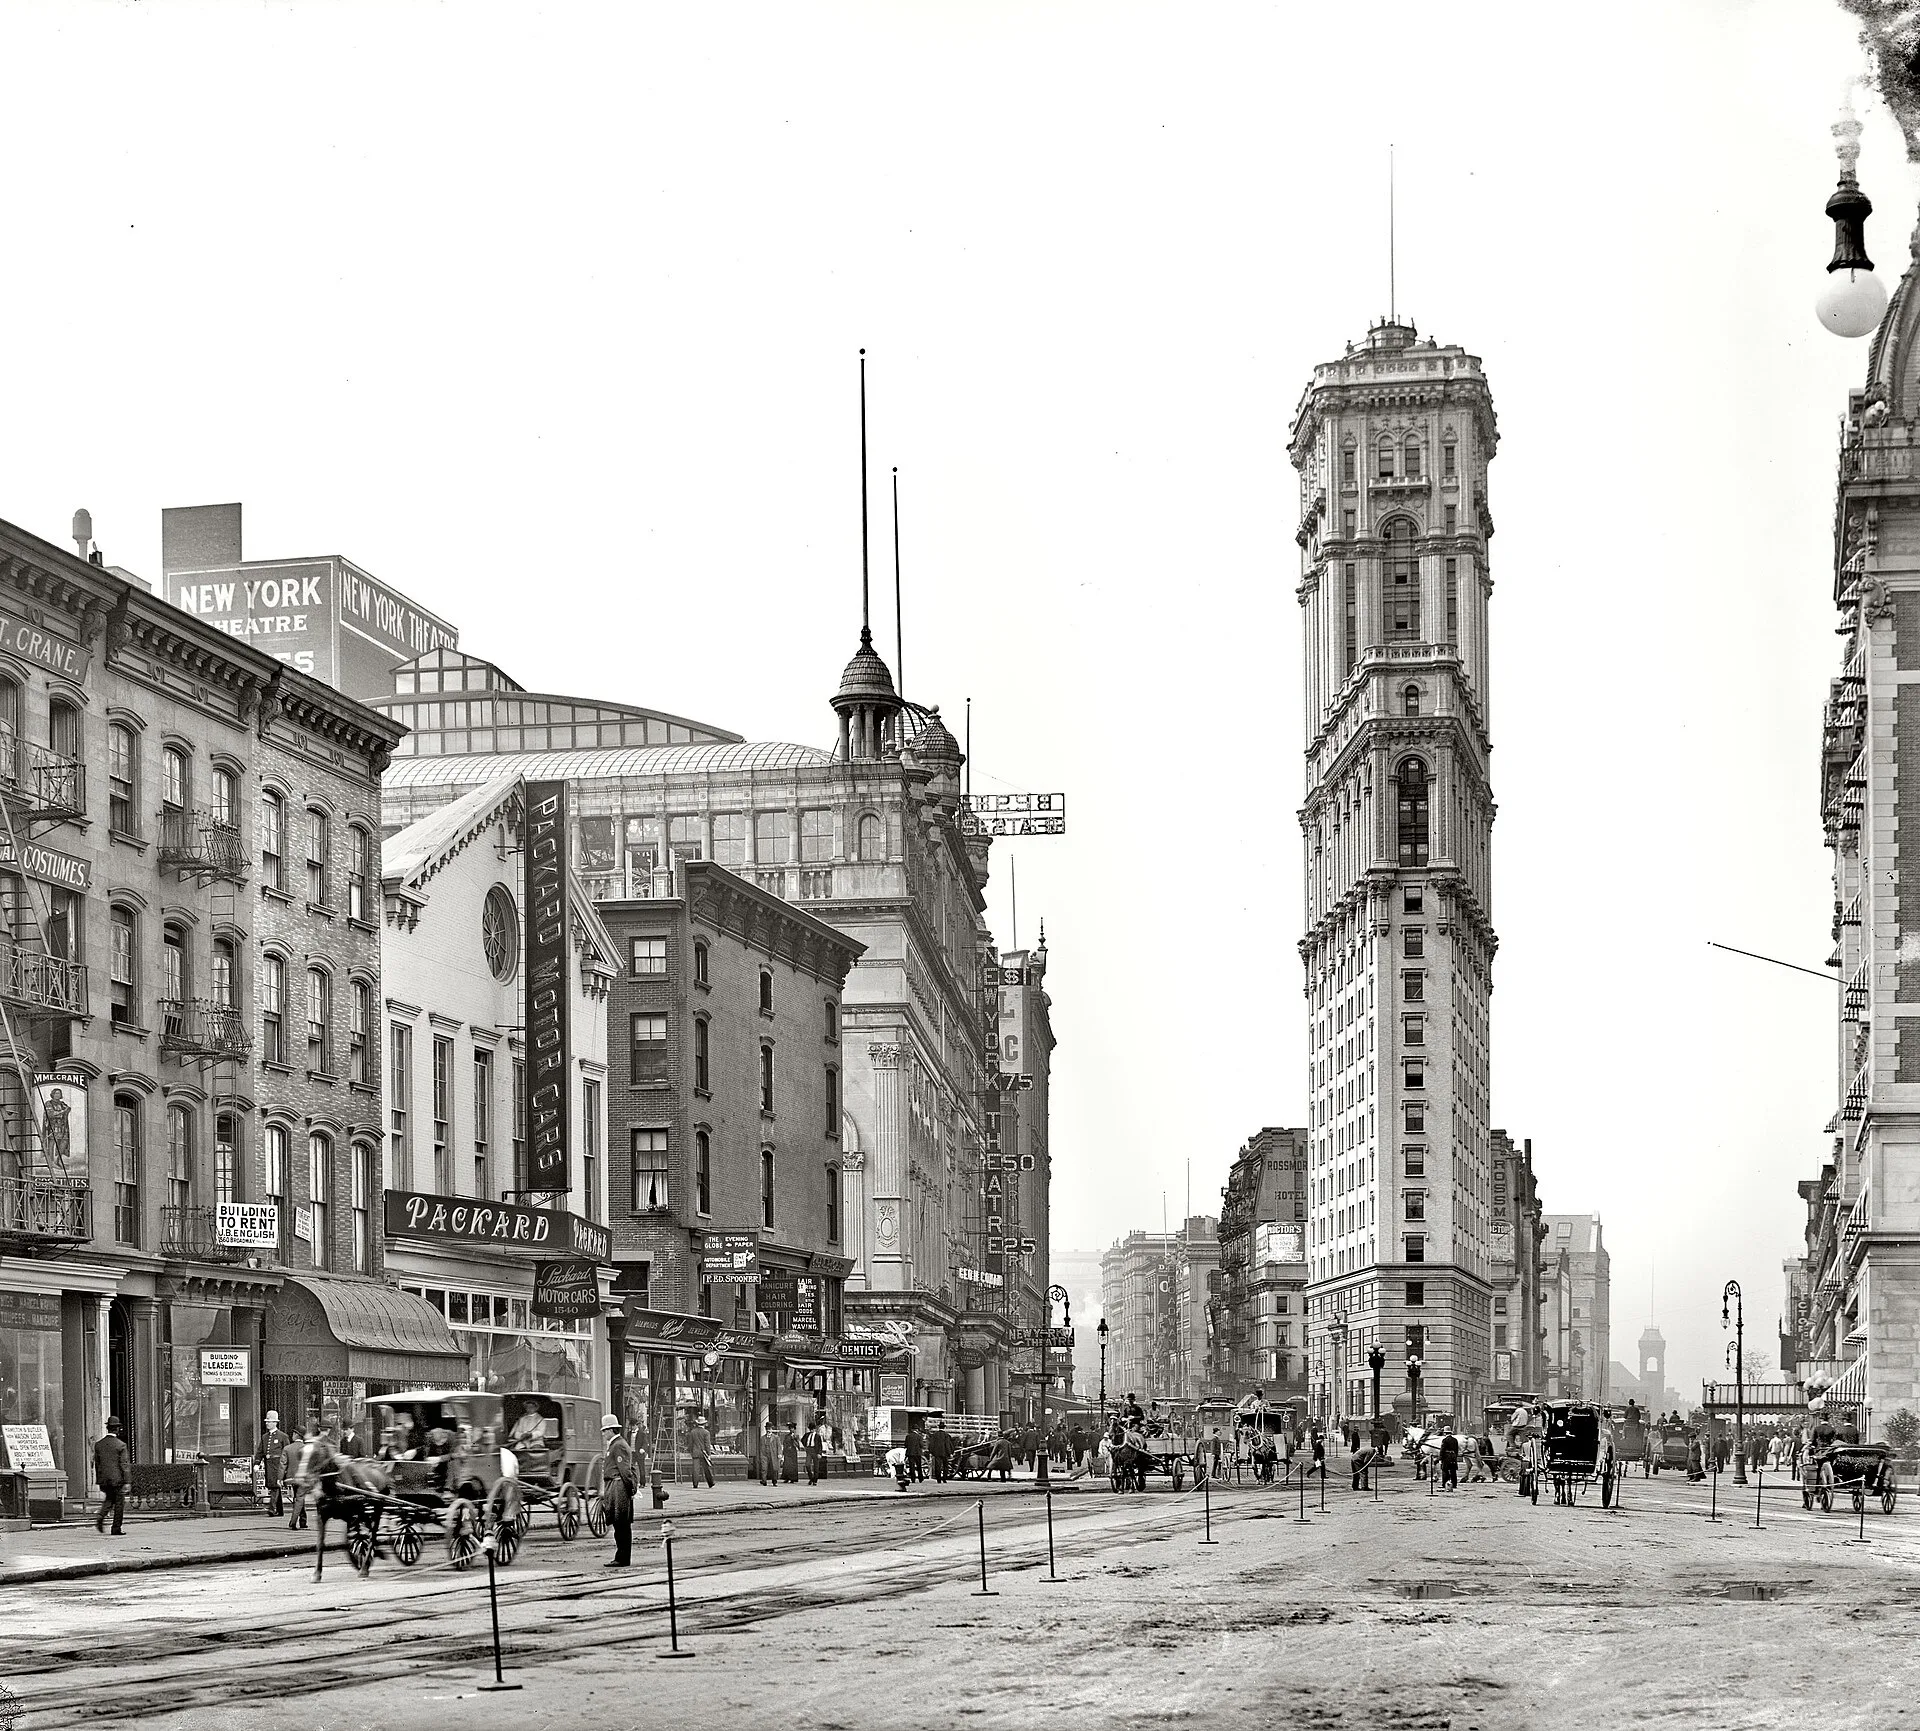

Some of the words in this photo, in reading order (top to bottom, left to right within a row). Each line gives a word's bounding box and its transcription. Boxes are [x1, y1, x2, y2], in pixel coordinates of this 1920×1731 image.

[180, 583, 235, 614] NEW
[243, 576, 323, 609] YORK
[343, 571, 371, 621] NEW
[372, 588, 405, 642] YORK
[208, 614, 308, 636] HEATRE
[16, 627, 79, 676] CRANE.
[23, 845, 87, 888] COSTUMES.
[530, 793, 563, 947] PACKARD
[984, 946, 999, 1006] NEW
[530, 957, 563, 1080] MOTOR
[984, 1011, 1000, 1091] YORK
[1001, 1073, 1033, 1091] 75
[531, 1083, 564, 1173] CARS
[1002, 1154, 1035, 1172] 50
[985, 1111, 1003, 1255] THEATRE
[1274, 1191, 1307, 1200] HOTEL
[220, 1205, 276, 1218] BUILDING
[405, 1196, 551, 1242] PACKARD
[218, 1217, 236, 1229] TO
[240, 1217, 276, 1230] RENT
[573, 1217, 608, 1258] PACKARD
[1003, 1237, 1036, 1255] 25
[537, 1263, 593, 1289] Packard
[759, 1282, 794, 1290] MANICURE
[538, 1288, 571, 1304] MOTOR
[570, 1289, 596, 1304] CARS
[553, 1306, 579, 1314] 1540
[791, 1323, 819, 1331] WAVING.
[1009, 1328, 1032, 1340] NEW
[841, 1345, 882, 1356] DENTIST.
[176, 1450, 199, 1460] LYRI
